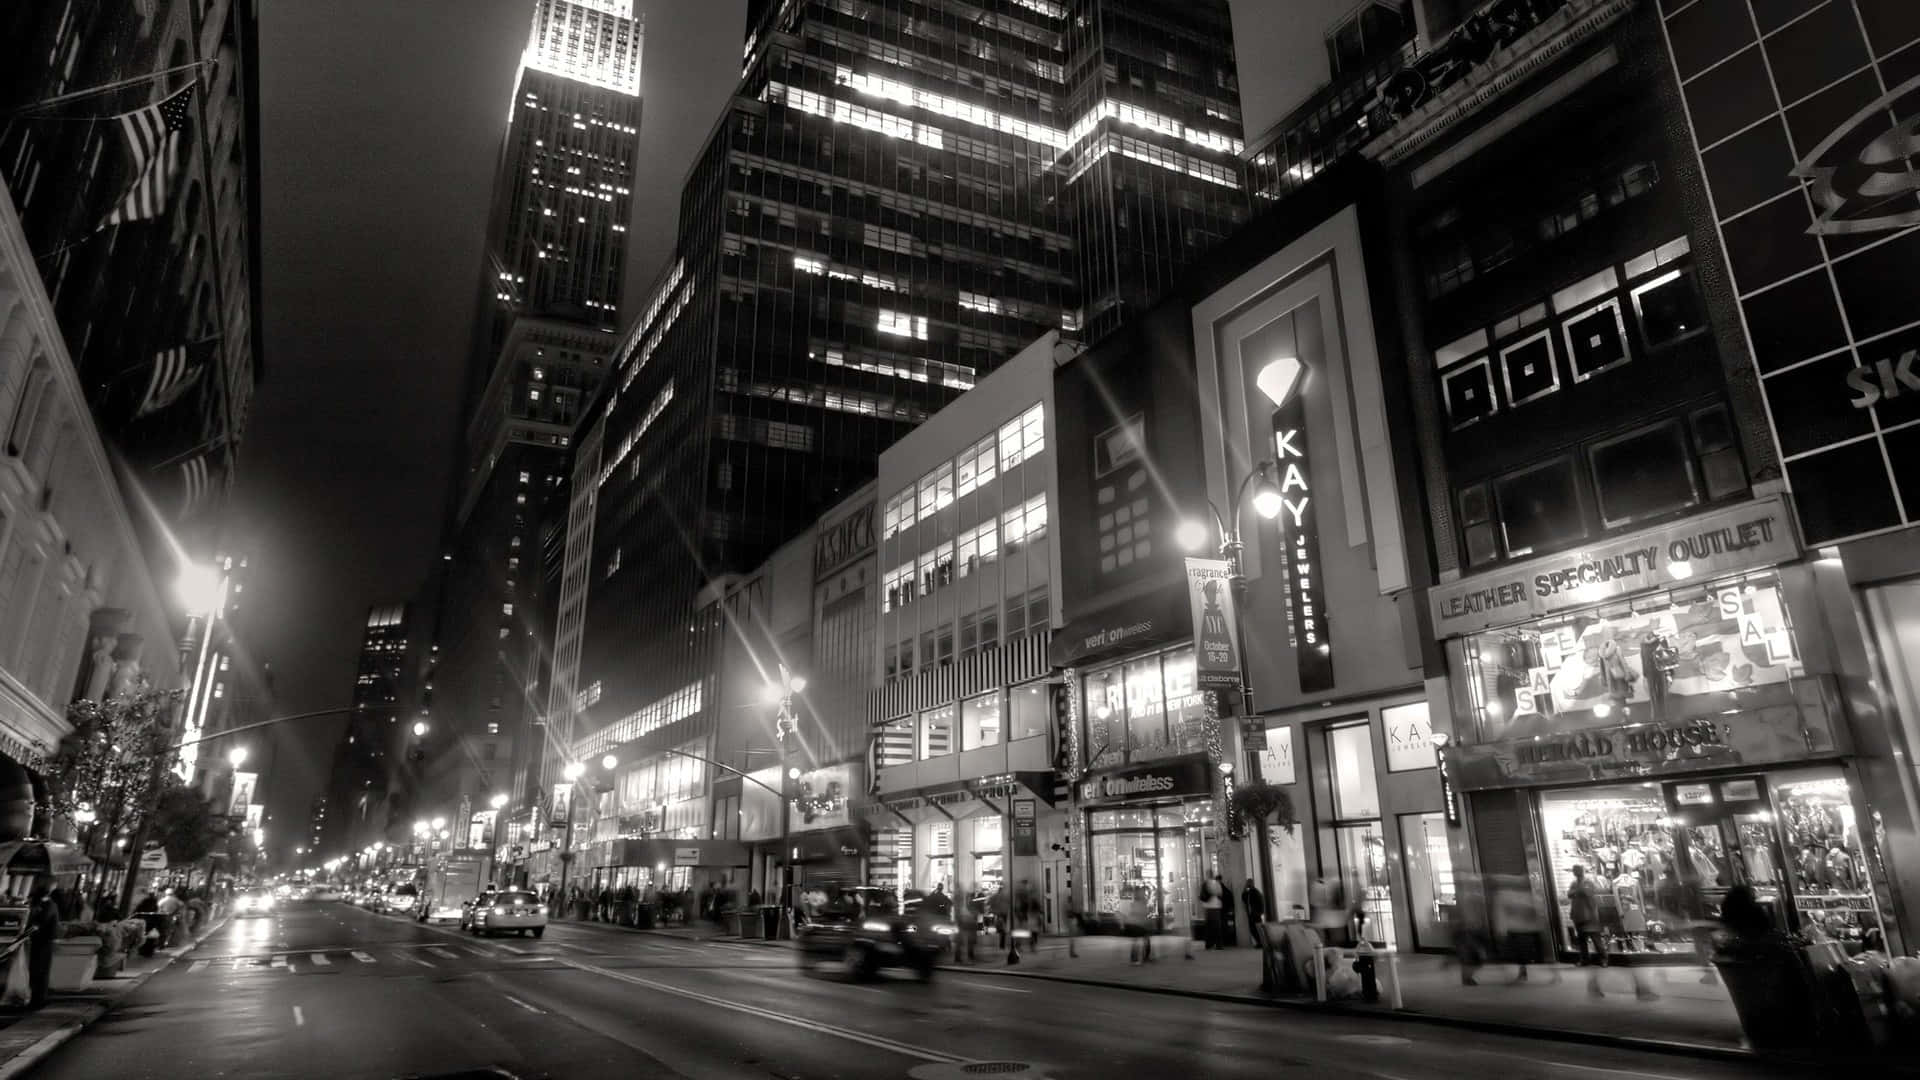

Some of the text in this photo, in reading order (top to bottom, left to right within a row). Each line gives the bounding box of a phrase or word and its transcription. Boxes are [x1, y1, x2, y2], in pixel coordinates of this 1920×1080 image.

[1276, 430, 1309, 526] KAY
[1440, 517, 1776, 619] LEATHER SPECIALTY OUTLET
[1297, 535, 1316, 644] JEWELERS
[1204, 640, 1230, 651] October
[1183, 694, 1203, 708] YORK
[1267, 744, 1289, 761] AY
[1517, 722, 1720, 763] HERALD HOUSE
